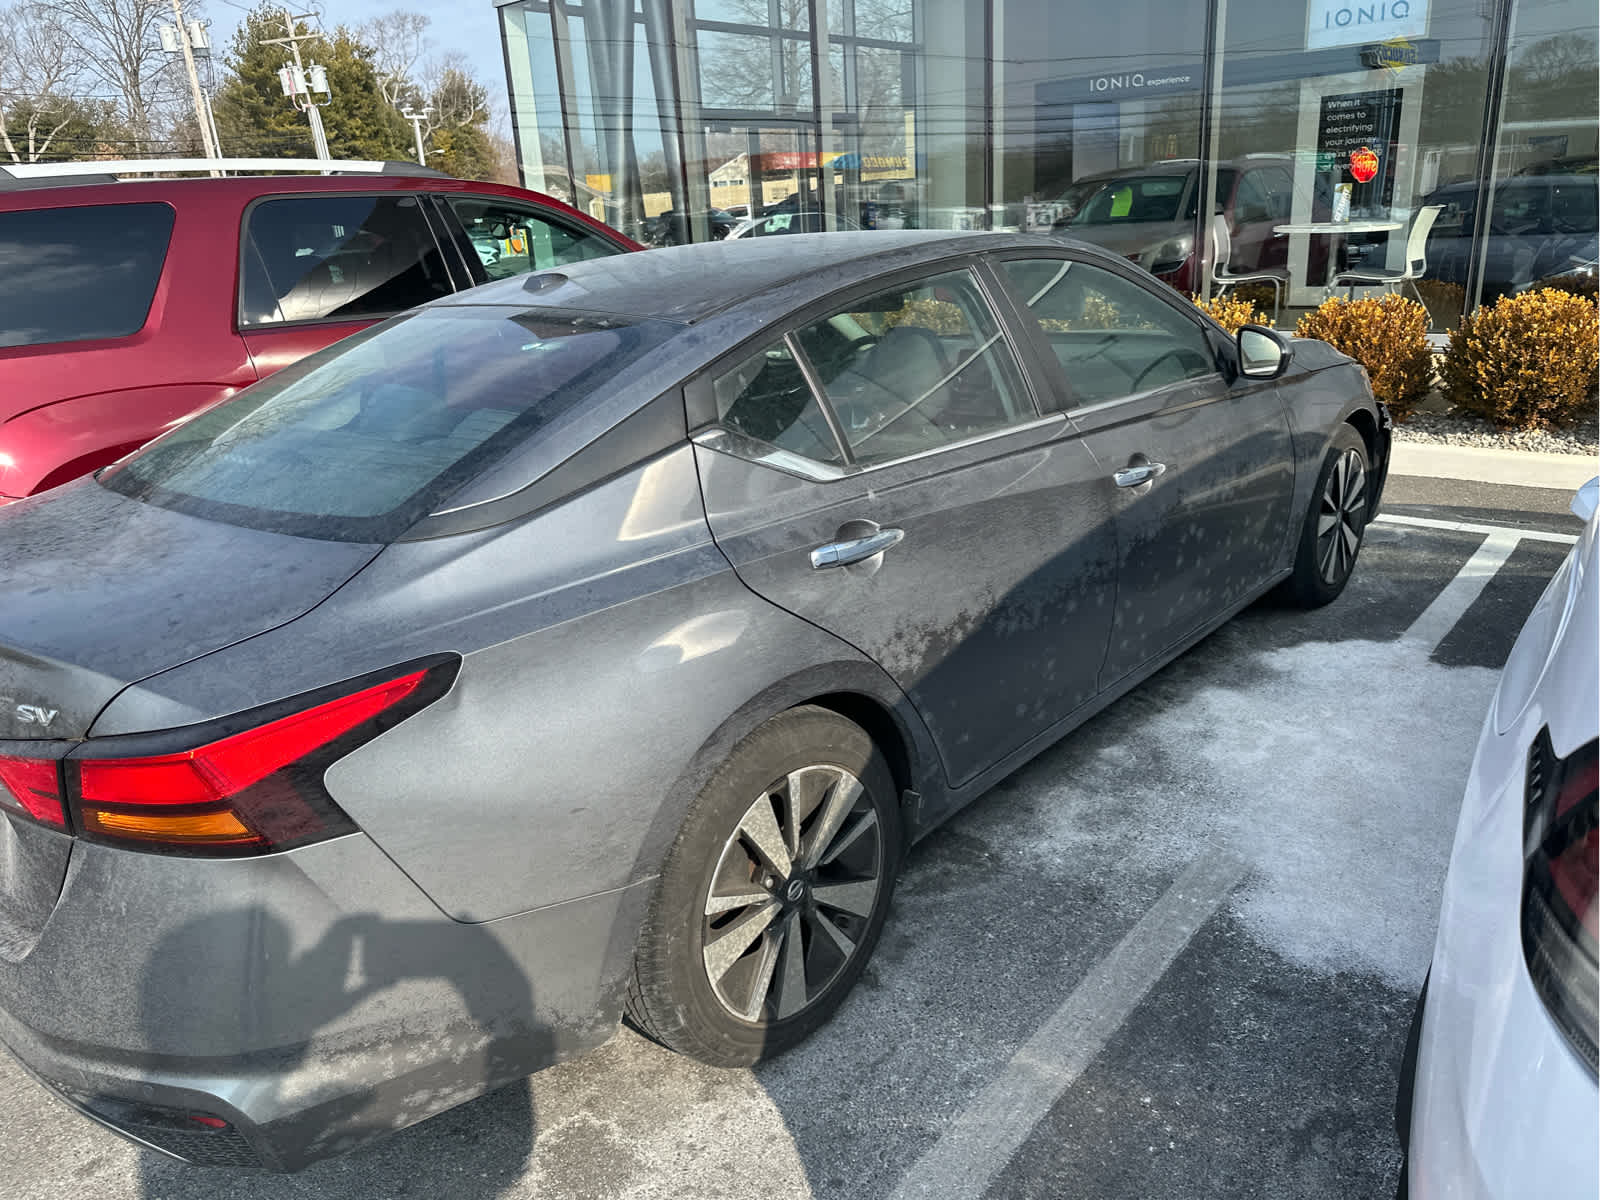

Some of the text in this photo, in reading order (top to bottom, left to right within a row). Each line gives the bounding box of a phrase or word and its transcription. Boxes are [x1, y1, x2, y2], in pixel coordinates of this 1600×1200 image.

[1325, 0, 1410, 29] IONIQ
[1089, 73, 1191, 92] IONIQ experience
[1327, 99, 1361, 109] When it
[1326, 113, 1355, 121] comes
[1326, 123, 1374, 134] electrifying
[1325, 138, 1344, 148] your
[15, 703, 59, 727] SV
